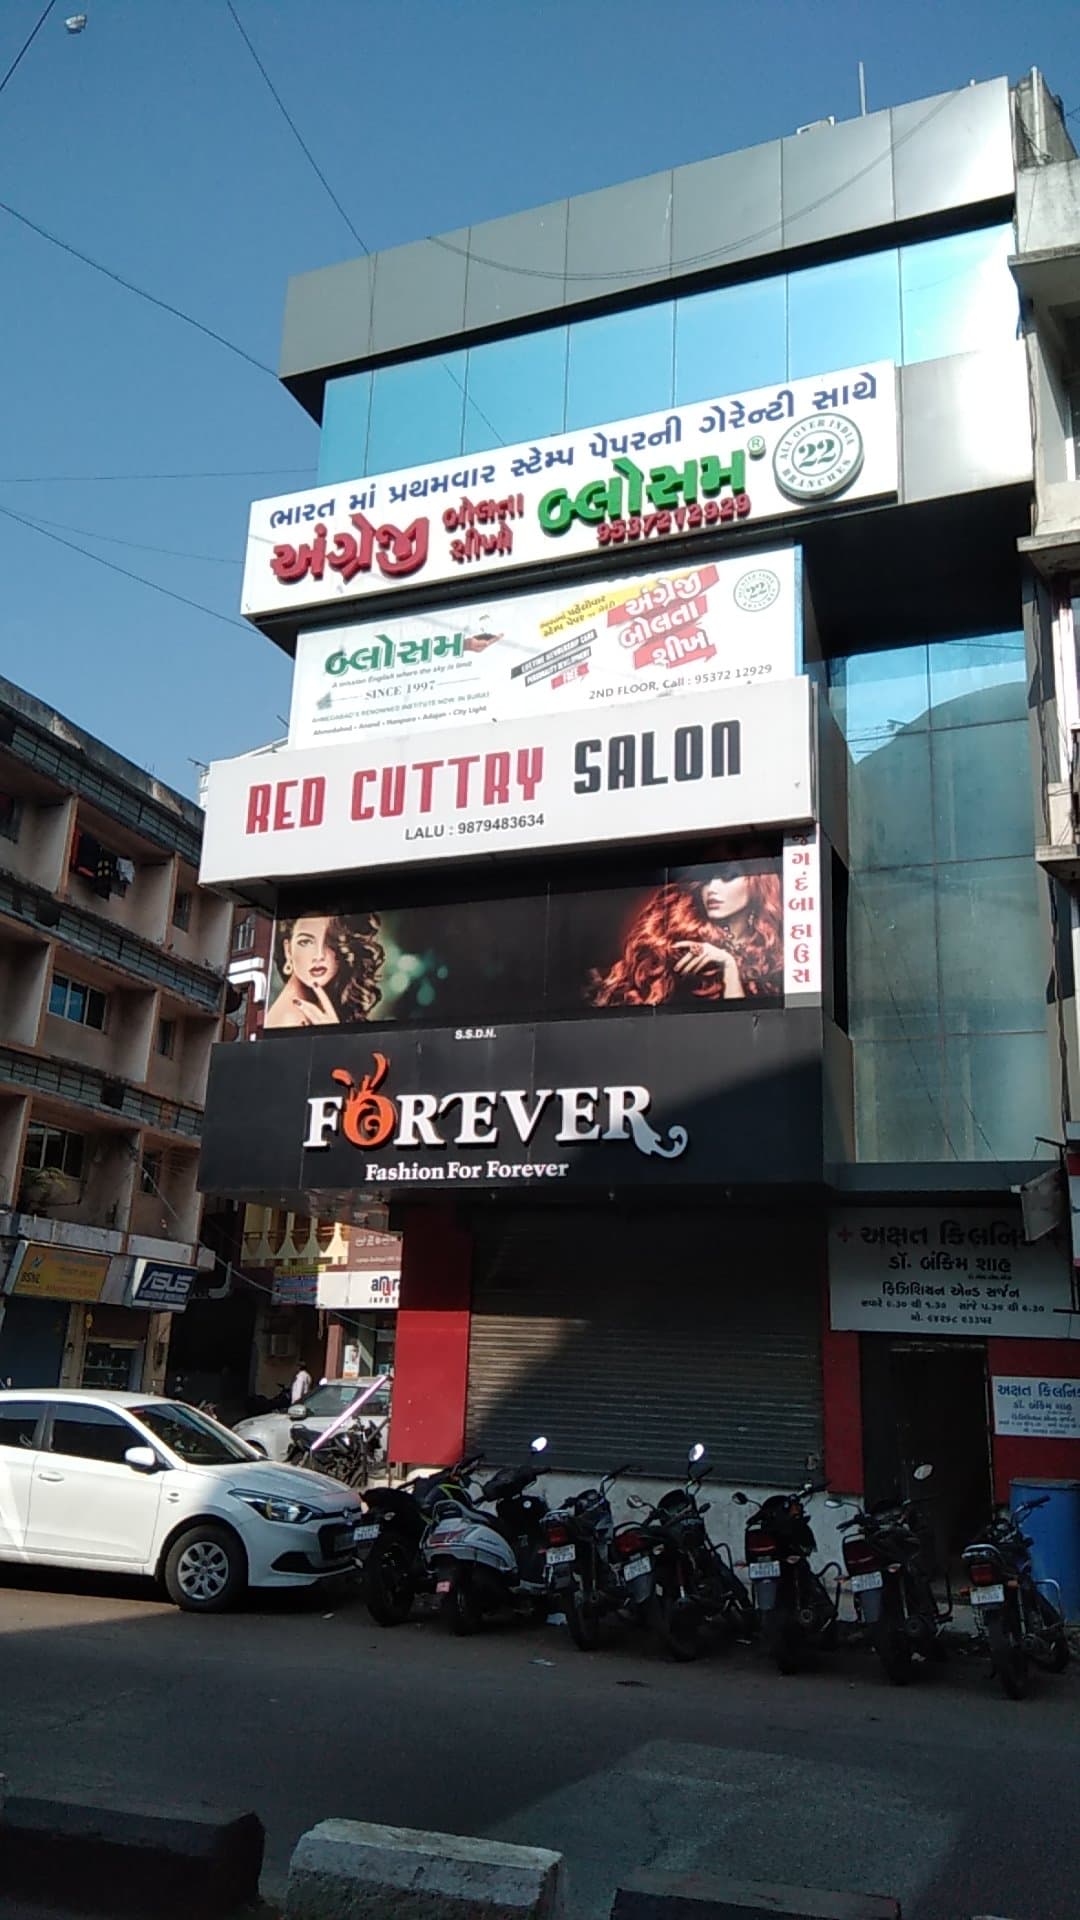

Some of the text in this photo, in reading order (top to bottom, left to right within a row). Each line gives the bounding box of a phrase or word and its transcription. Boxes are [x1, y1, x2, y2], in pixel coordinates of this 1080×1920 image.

[793, 419, 825, 437] OVER
[829, 419, 855, 445] INDIA
[270, 499, 335, 528] ભારત
[349, 484, 376, 509] માં
[389, 465, 495, 503] પ્રથમવાર
[511, 447, 574, 477] સ્ટેમ્પ
[589, 415, 681, 458] પેપરની
[813, 372, 877, 410] સાથે
[798, 439, 836, 468] 22
[782, 460, 851, 488] BRANCHES
[538, 449, 747, 537] બ્લોસમ
[270, 513, 431, 585] અંગ્રેજી
[625, 571, 702, 616] અંગ્રેજી
[325, 631, 464, 675] બ્લોસમ
[365, 680, 436, 700] SINCE 1997
[589, 686, 614, 700] 2ND
[617, 681, 660, 695] FLOOR,
[662, 677, 685, 690] Call
[695, 669, 731, 685] 95372
[735, 664, 773, 679] 12929
[453, 708, 467, 716] City
[469, 705, 487, 714] Light
[246, 720, 741, 834] RED CUTTRY SALON
[405, 824, 445, 841] LALU
[457, 812, 545, 835] 9879483634
[455, 1028, 497, 1041] S.S.D.N.
[303, 1058, 689, 1159] FOREVER
[365, 1161, 569, 1182] Fashion For Forever
[142, 1271, 193, 1293] ASUS
